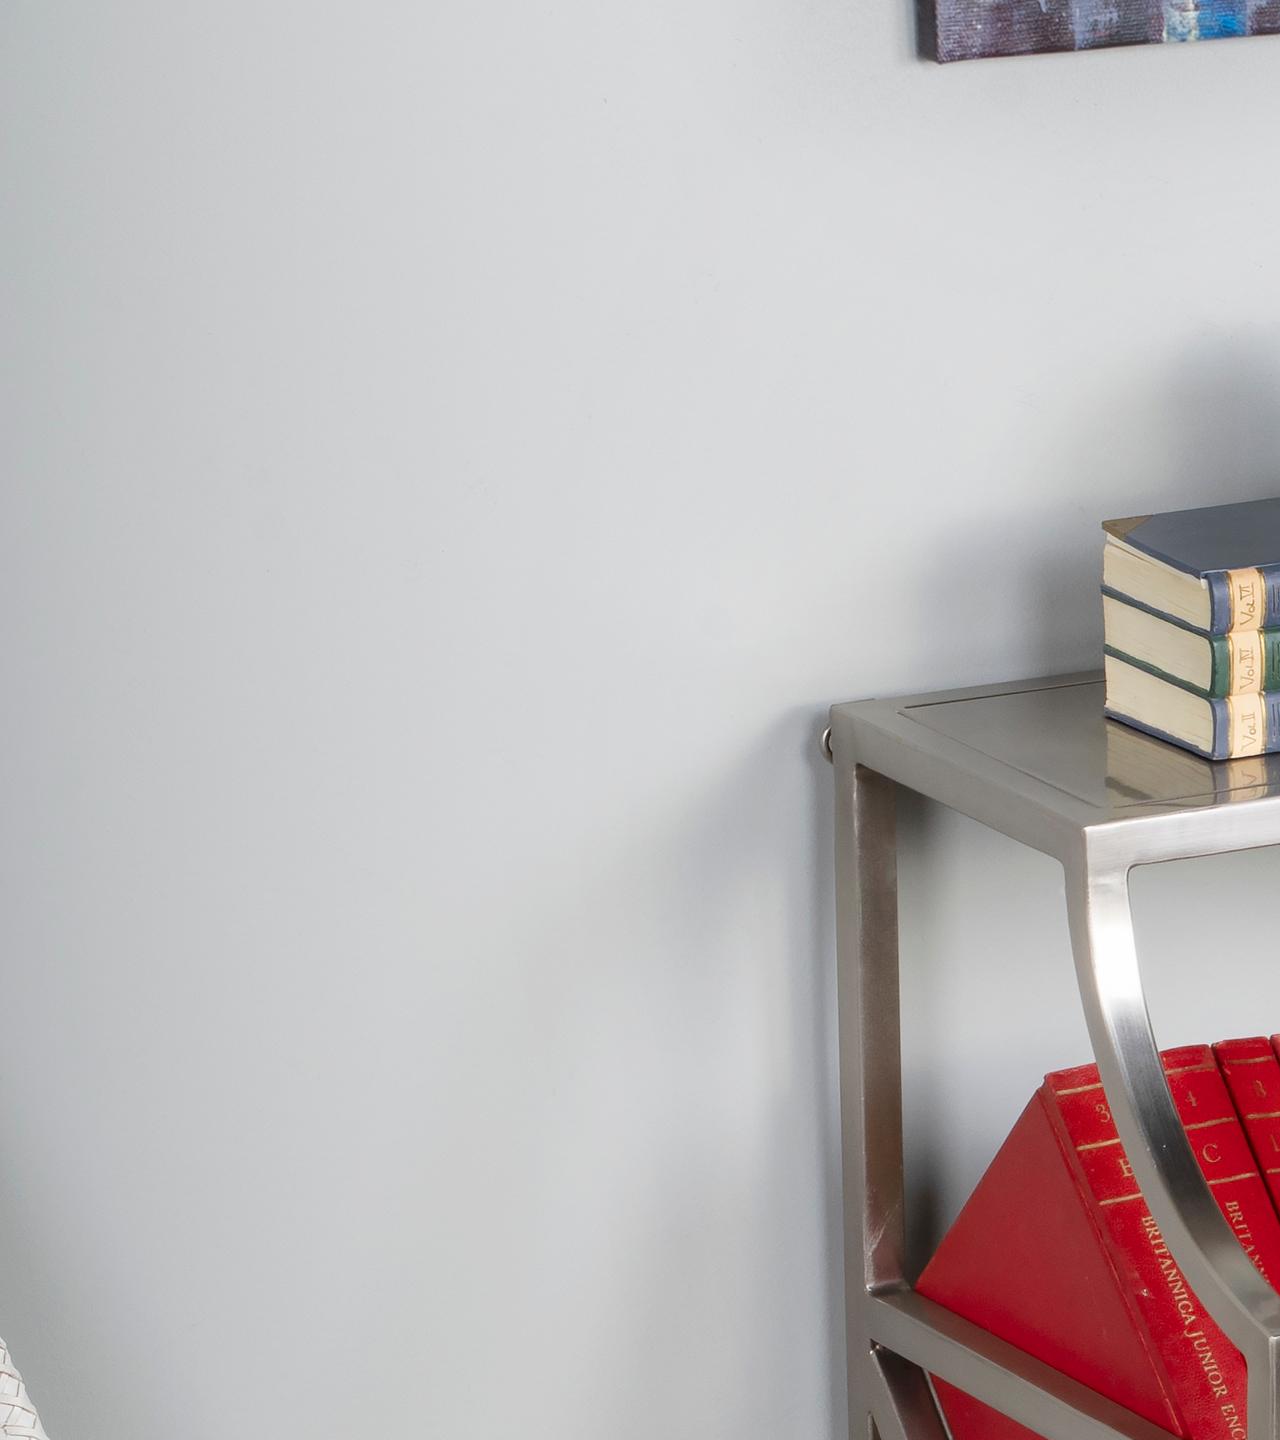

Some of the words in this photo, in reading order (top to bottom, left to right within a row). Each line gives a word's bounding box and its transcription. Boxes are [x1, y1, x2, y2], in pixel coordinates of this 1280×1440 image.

[1095, 1104, 1111, 1123] 3
[1202, 1142, 1222, 1163] C
[1141, 1215, 1197, 1327] BRITANNICA
[1184, 1322, 1229, 1400] JUNIOR
